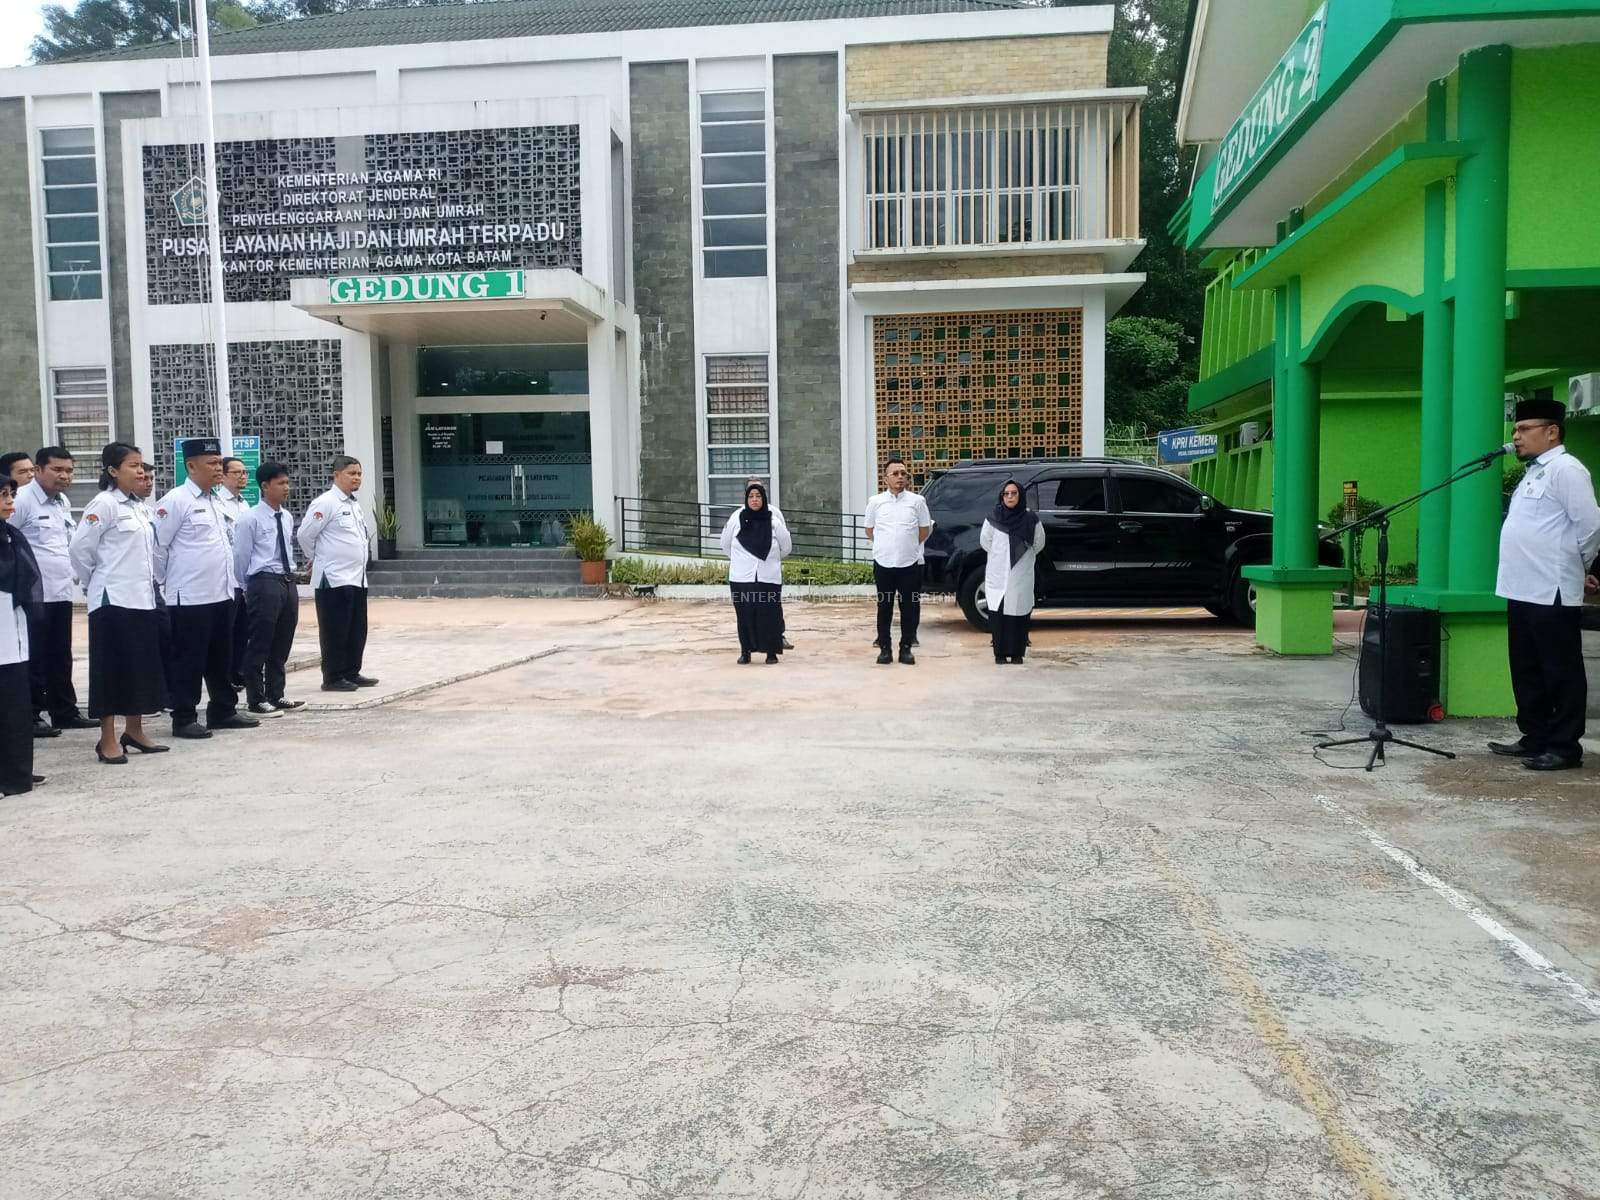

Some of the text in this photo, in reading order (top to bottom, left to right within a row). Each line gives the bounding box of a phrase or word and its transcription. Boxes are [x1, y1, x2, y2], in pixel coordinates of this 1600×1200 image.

[1215, 26, 1320, 199] GEDUNG 2
[278, 168, 442, 188] KEMENTERIAN AGAMA RI
[283, 187, 436, 207] DIREKTORAT JENDERAL
[232, 203, 484, 227] PENYELENGGARAAN HAJI DAN UMRAH
[162, 222, 565, 257] PUSA LAYANAN HAJI DAN UMRAH TERPADU
[221, 249, 512, 273] KANTOR KEMENTERIAN AGAMA KOTA BATAM
[330, 271, 523, 302] GEDUNG 1
[233, 439, 255, 449] PTSP
